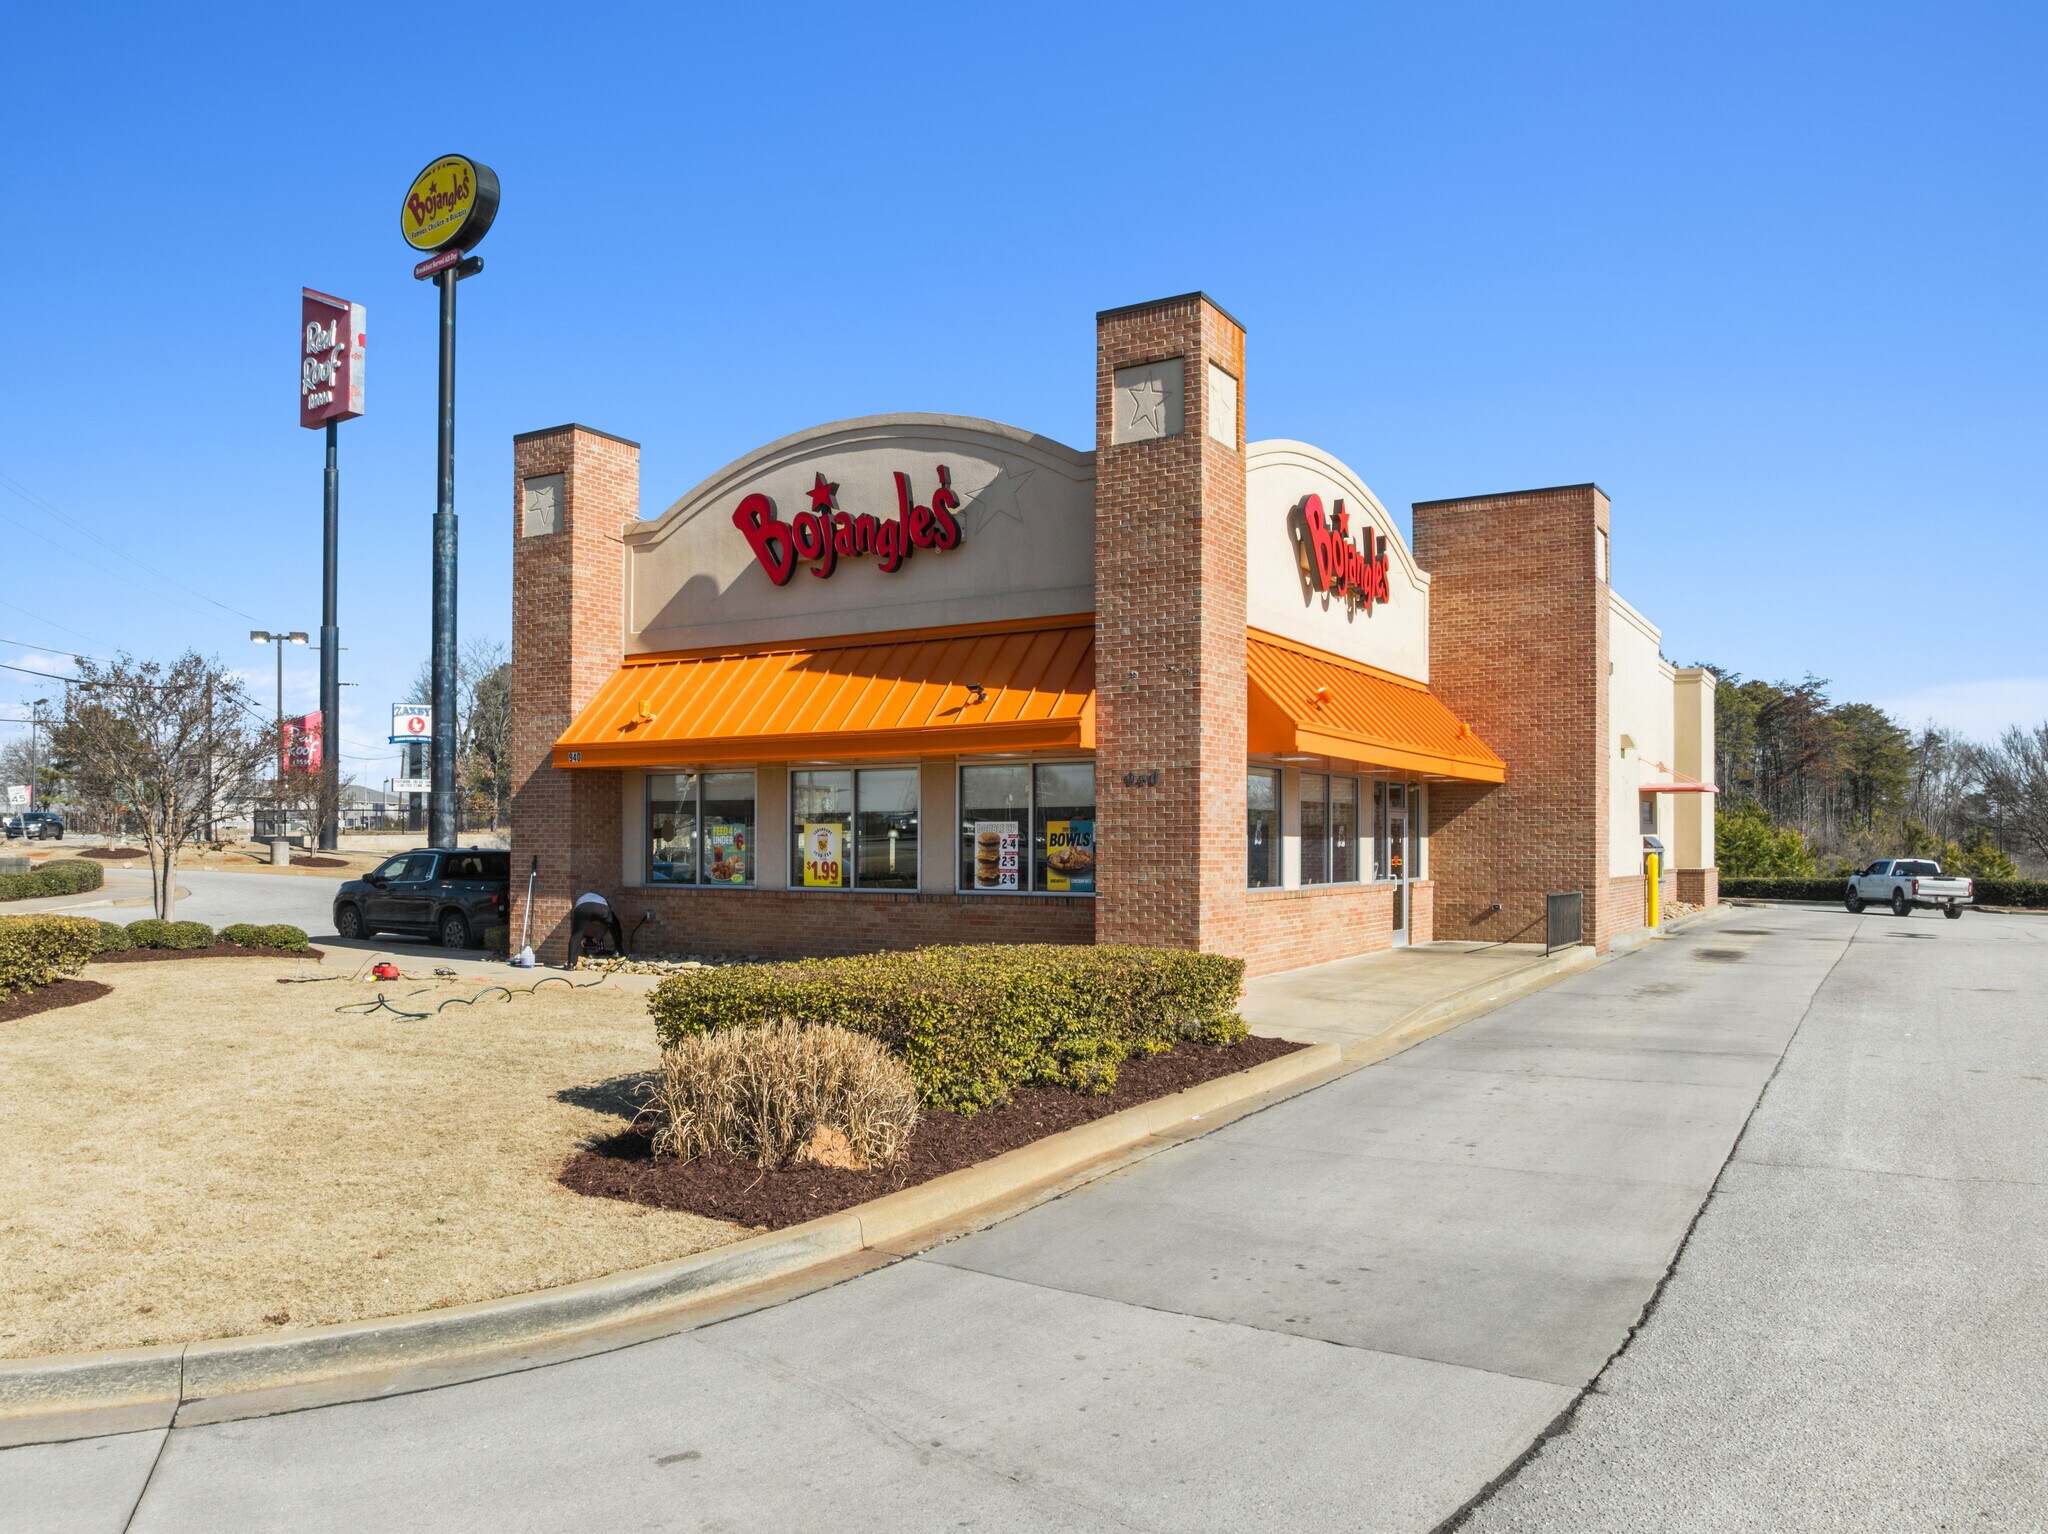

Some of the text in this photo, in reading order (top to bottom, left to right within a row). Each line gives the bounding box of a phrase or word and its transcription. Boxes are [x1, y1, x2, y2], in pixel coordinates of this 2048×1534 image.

[411, 227, 427, 239] Famous
[427, 218, 445, 231] Chicken
[449, 208, 468, 222] Biscuits
[432, 257, 445, 269] Served
[450, 252, 458, 262] Day
[306, 319, 337, 354] Red
[302, 343, 345, 395] Roof
[732, 464, 961, 586] Bojangles'
[713, 826, 728, 836] FEED
[976, 824, 1016, 833] DOUBLE UP
[712, 836, 734, 845] UNDER
[1002, 839, 1007, 849] 2
[1049, 833, 1091, 847] BOWLS
[1002, 857, 1007, 866] 2
[806, 861, 839, 881] $1.99
[1002, 874, 1007, 884] 2
